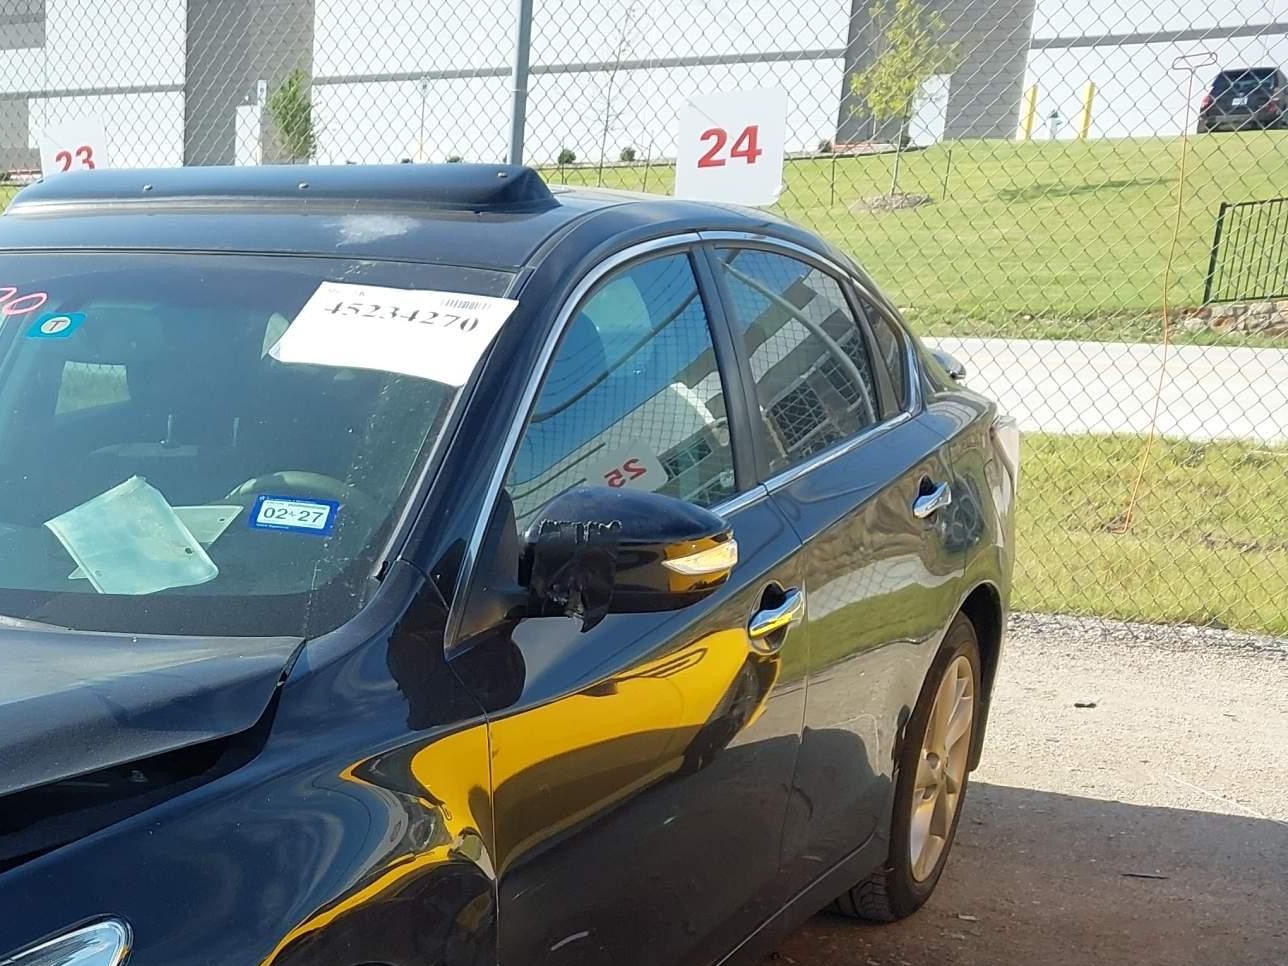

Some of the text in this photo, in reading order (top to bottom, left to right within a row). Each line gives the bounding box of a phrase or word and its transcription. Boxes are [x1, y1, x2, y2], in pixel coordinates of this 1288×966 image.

[55, 145, 95, 172] 23
[697, 125, 762, 168] 24
[324, 301, 480, 332] 45234270
